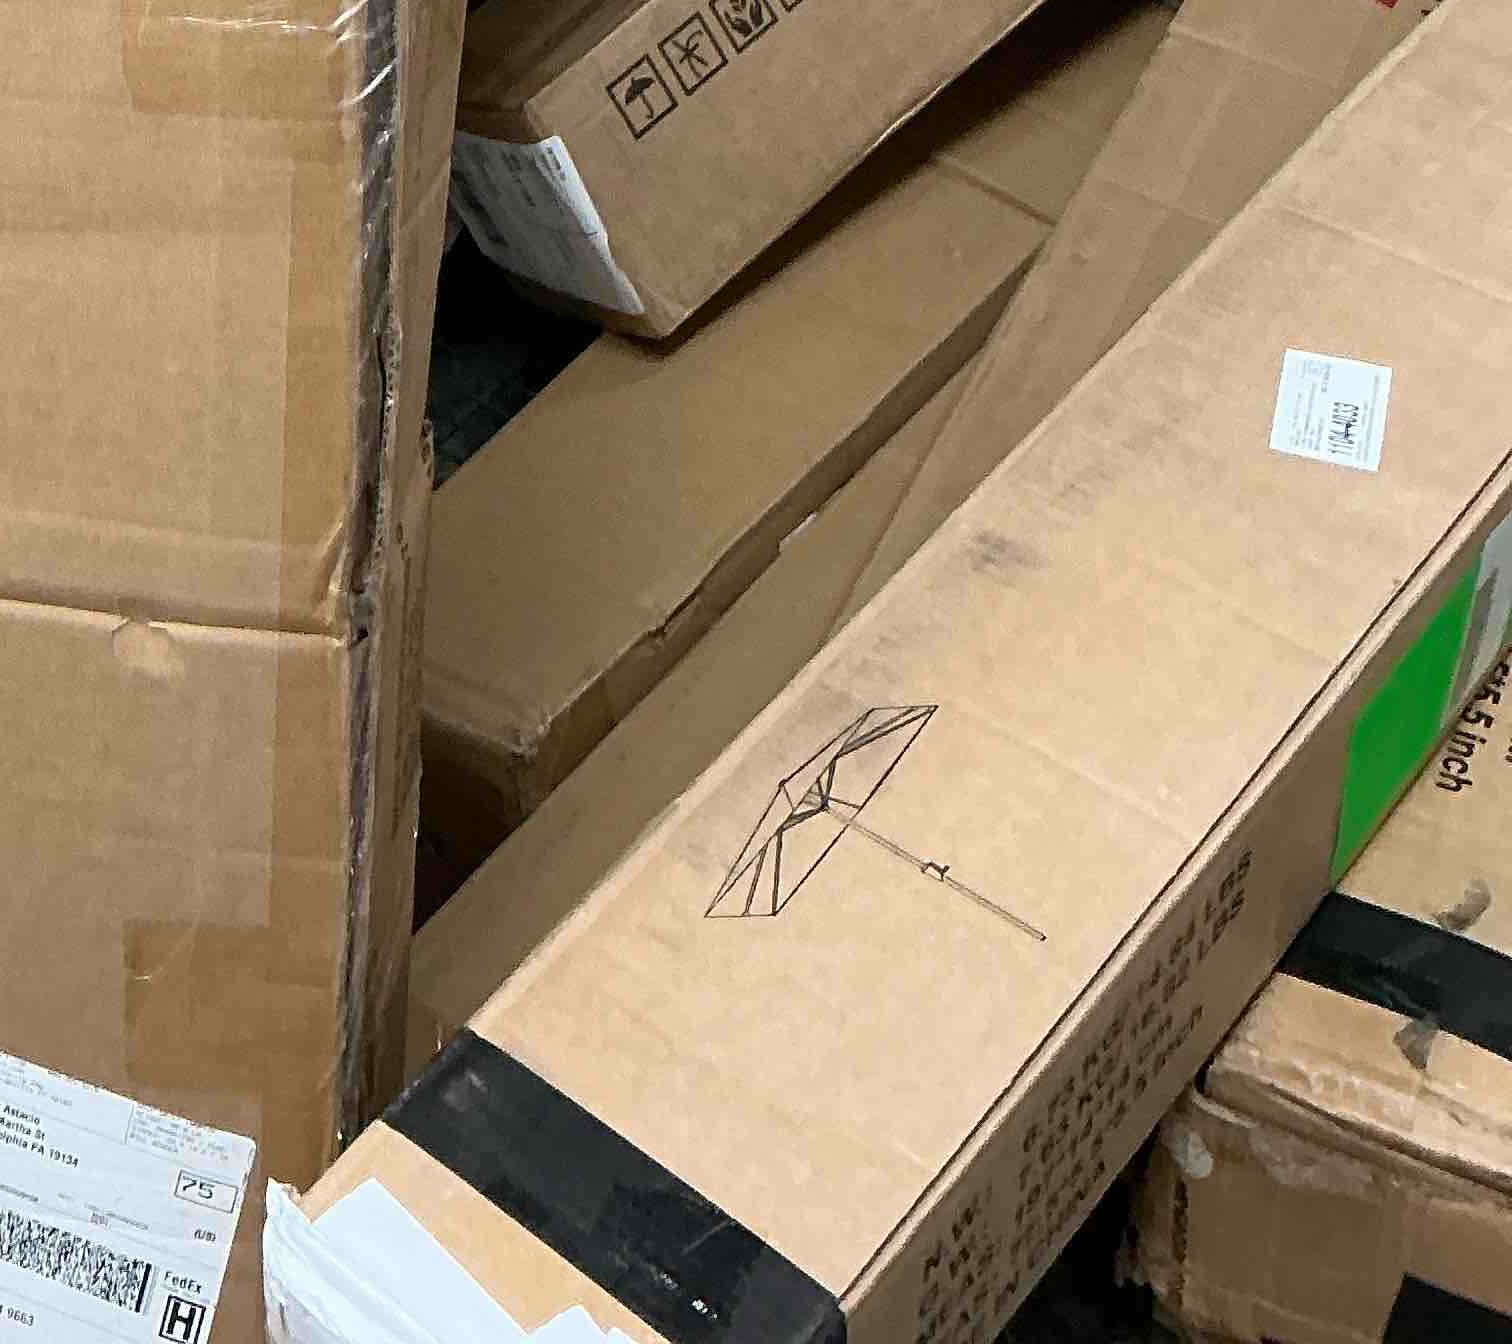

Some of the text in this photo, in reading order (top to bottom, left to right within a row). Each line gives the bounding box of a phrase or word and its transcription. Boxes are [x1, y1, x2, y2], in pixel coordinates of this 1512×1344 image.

[1435, 729, 1488, 793] inch
[180, 1177, 214, 1200] 75
[163, 1269, 204, 1295] FedEx
